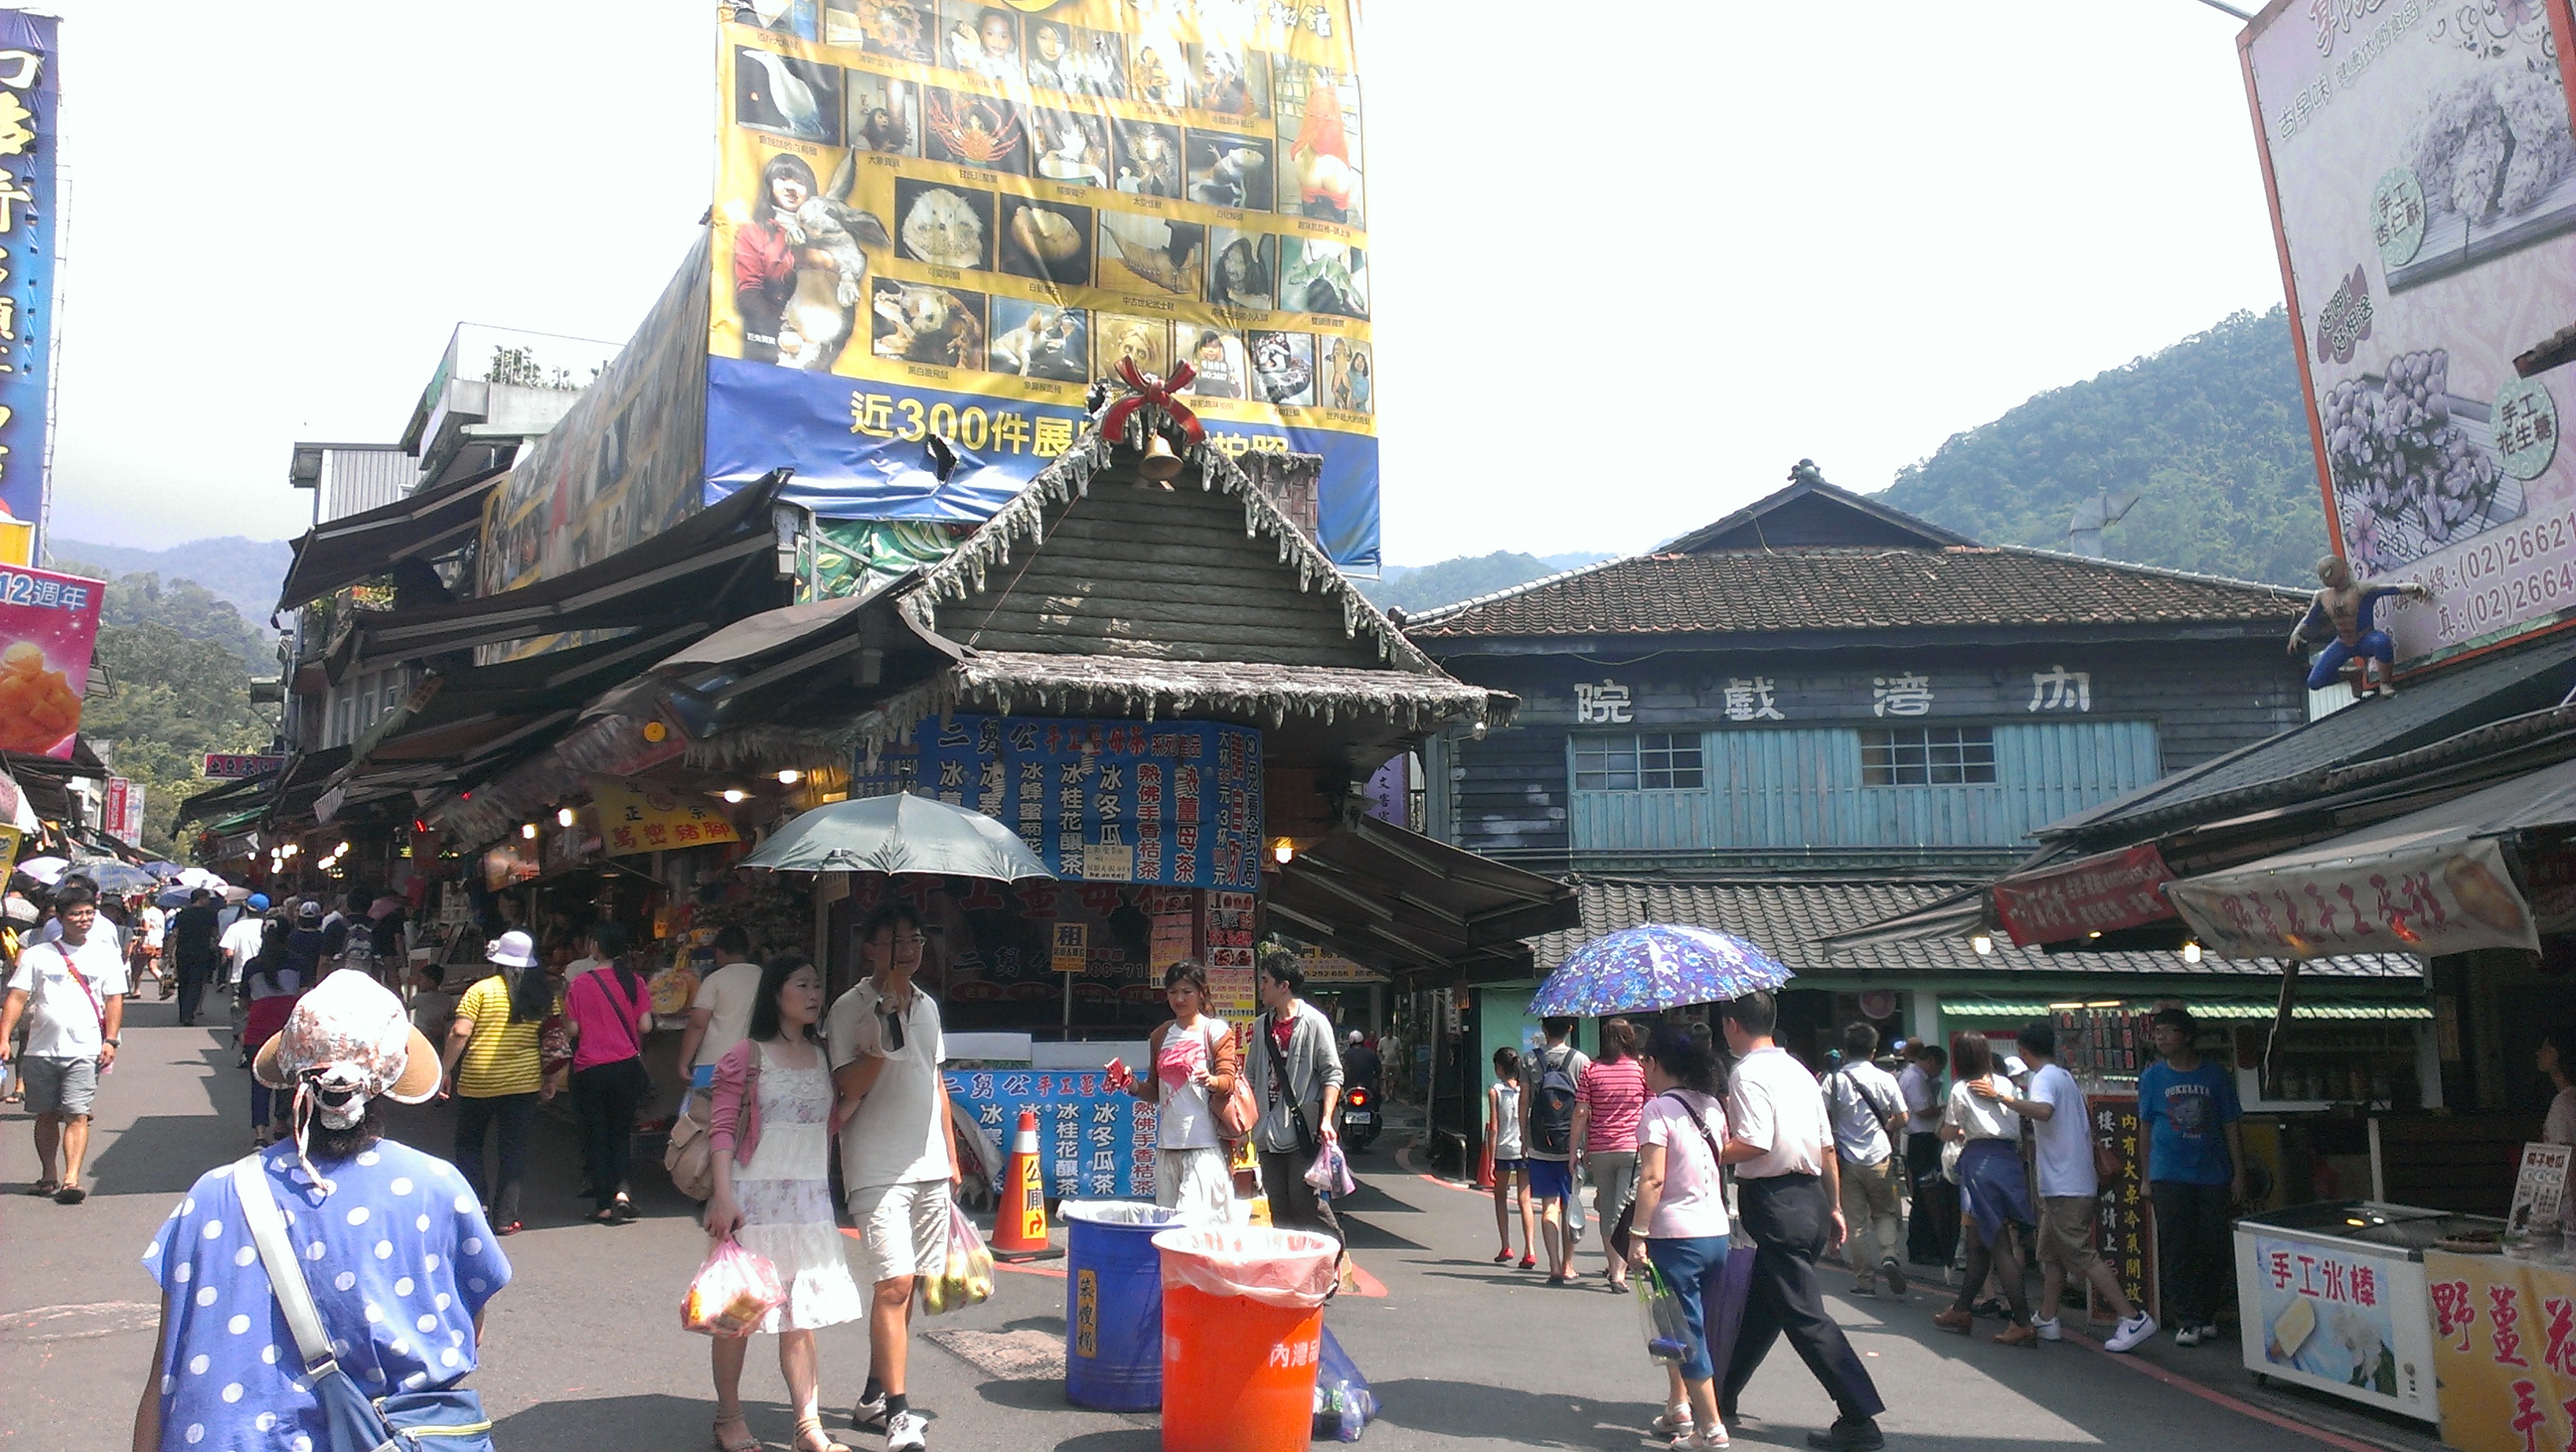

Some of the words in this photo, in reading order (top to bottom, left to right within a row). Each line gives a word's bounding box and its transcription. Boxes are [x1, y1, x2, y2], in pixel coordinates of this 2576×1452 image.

[2378, 182, 2409, 219] 手工
[849, 390, 1092, 458] 近300件展
[2500, 390, 2539, 431] 手工
[2439, 559, 2576, 641] 真:(02)2664
[938, 718, 1039, 754] 二舅公
[1018, 762, 1043, 861] 冰蜂蜜菊花
[1057, 925, 1084, 946] 租
[944, 1073, 1032, 1099] 二舅公
[1092, 1102, 1117, 1196] 冰冬瓜茶
[1132, 1100, 1158, 1196] 熱佛手香桔茶
